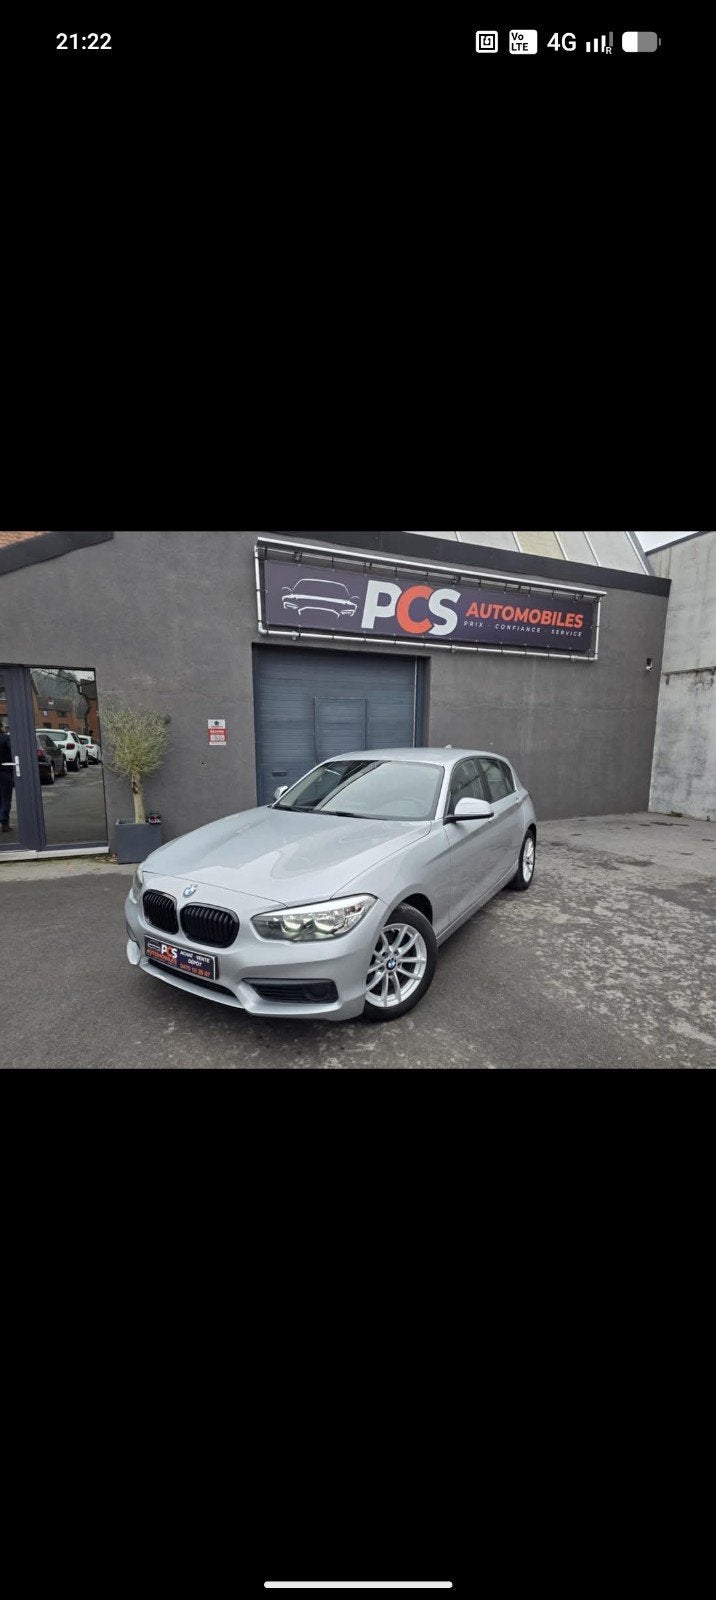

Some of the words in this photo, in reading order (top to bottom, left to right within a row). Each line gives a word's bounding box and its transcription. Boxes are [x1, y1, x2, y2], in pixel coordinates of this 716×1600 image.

[361, 580, 461, 636] PCS
[465, 602, 584, 629] AUTOMOBILES
[463, 620, 484, 628] PRIX
[495, 624, 541, 634] CONFIANCE
[551, 629, 583, 638] SERVICE
[161, 944, 178, 959] PCS
[196, 955, 210, 964] VENTE
